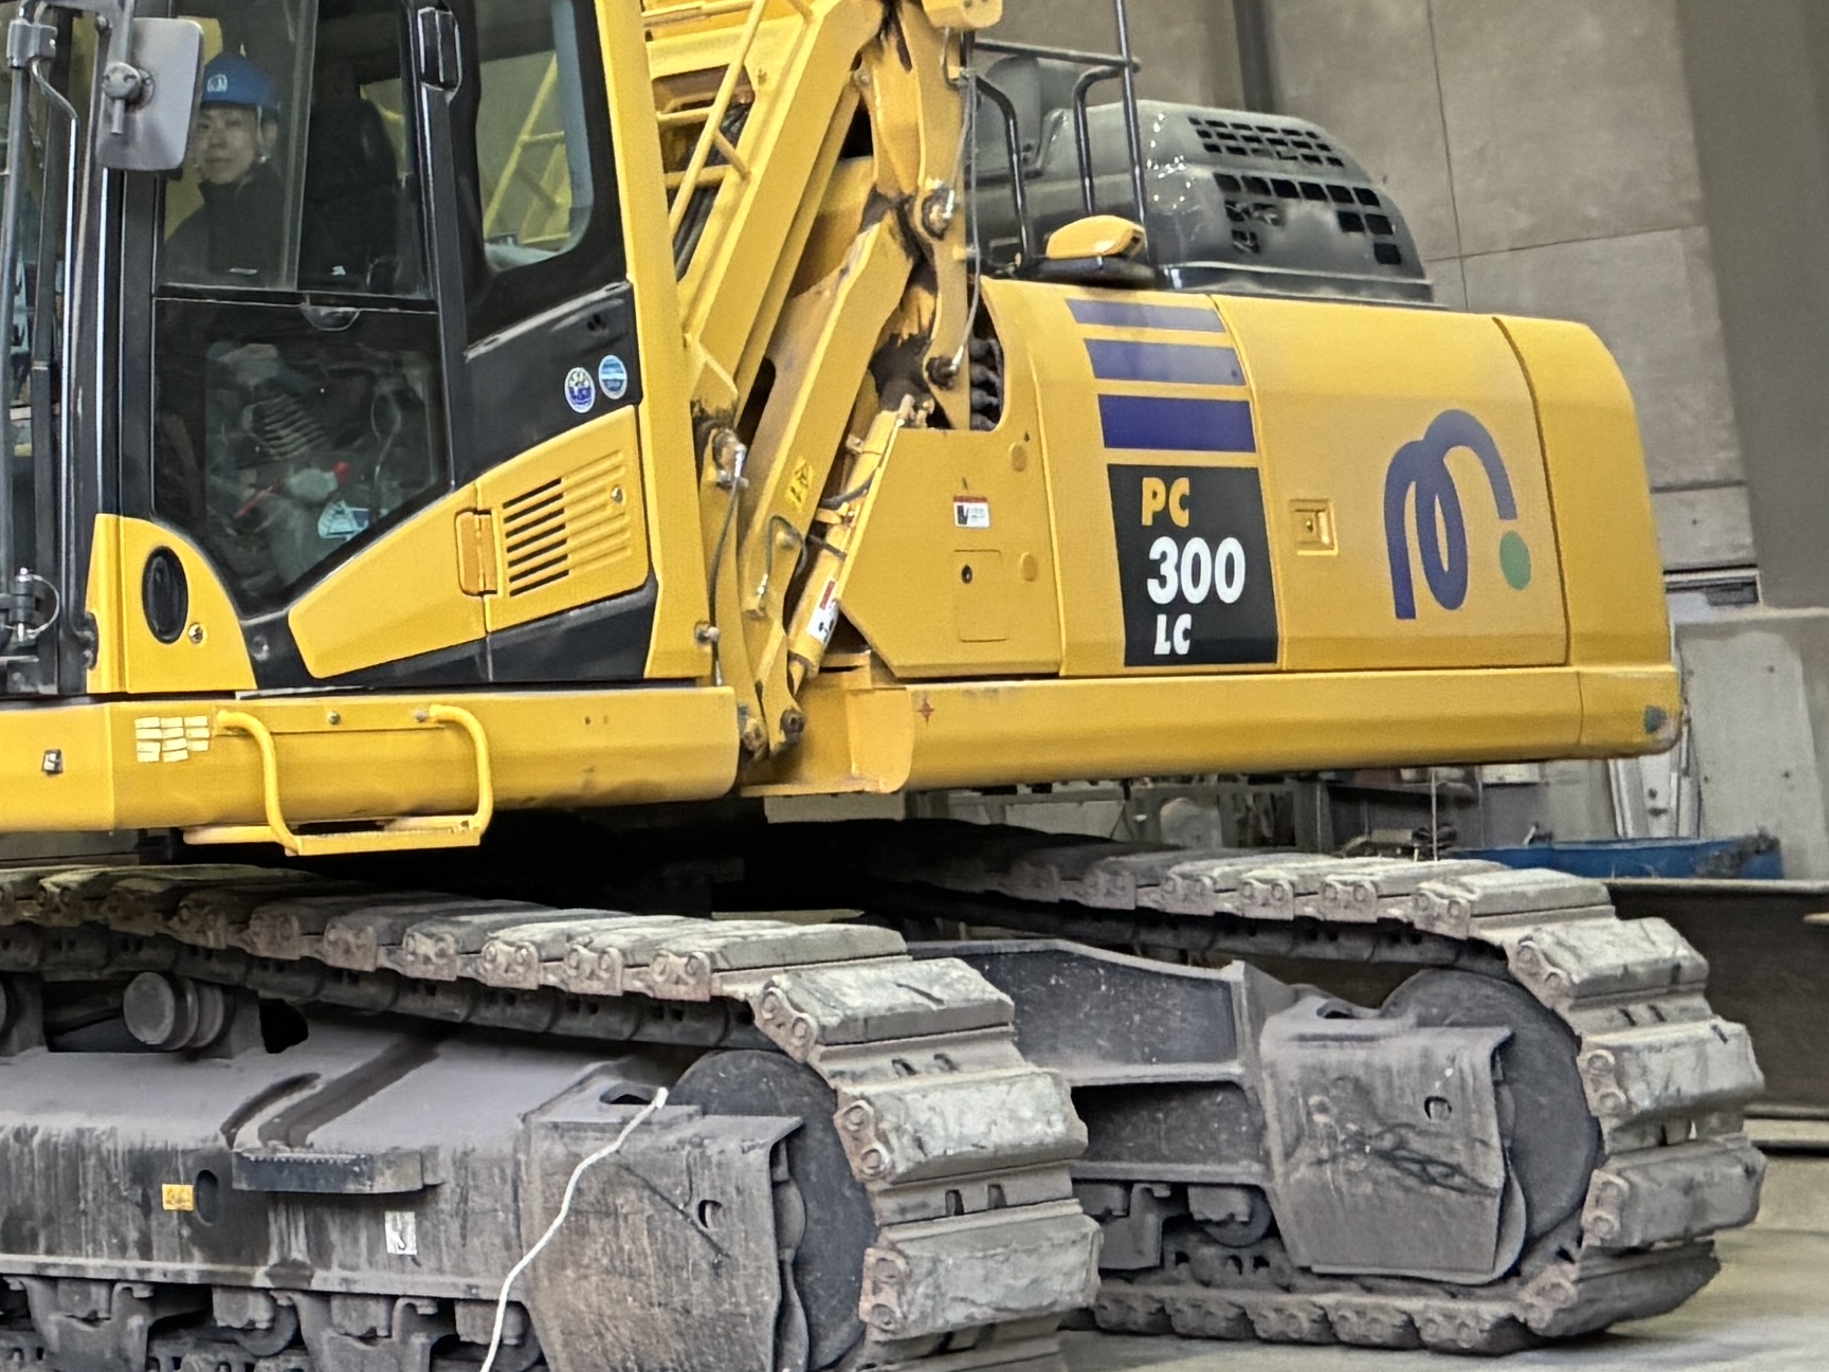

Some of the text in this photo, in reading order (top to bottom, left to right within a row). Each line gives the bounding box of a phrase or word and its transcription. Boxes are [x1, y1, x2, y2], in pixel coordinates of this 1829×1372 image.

[1142, 477, 1190, 528] PC
[1147, 536, 1246, 605] 300
[1154, 613, 1192, 655] LC
